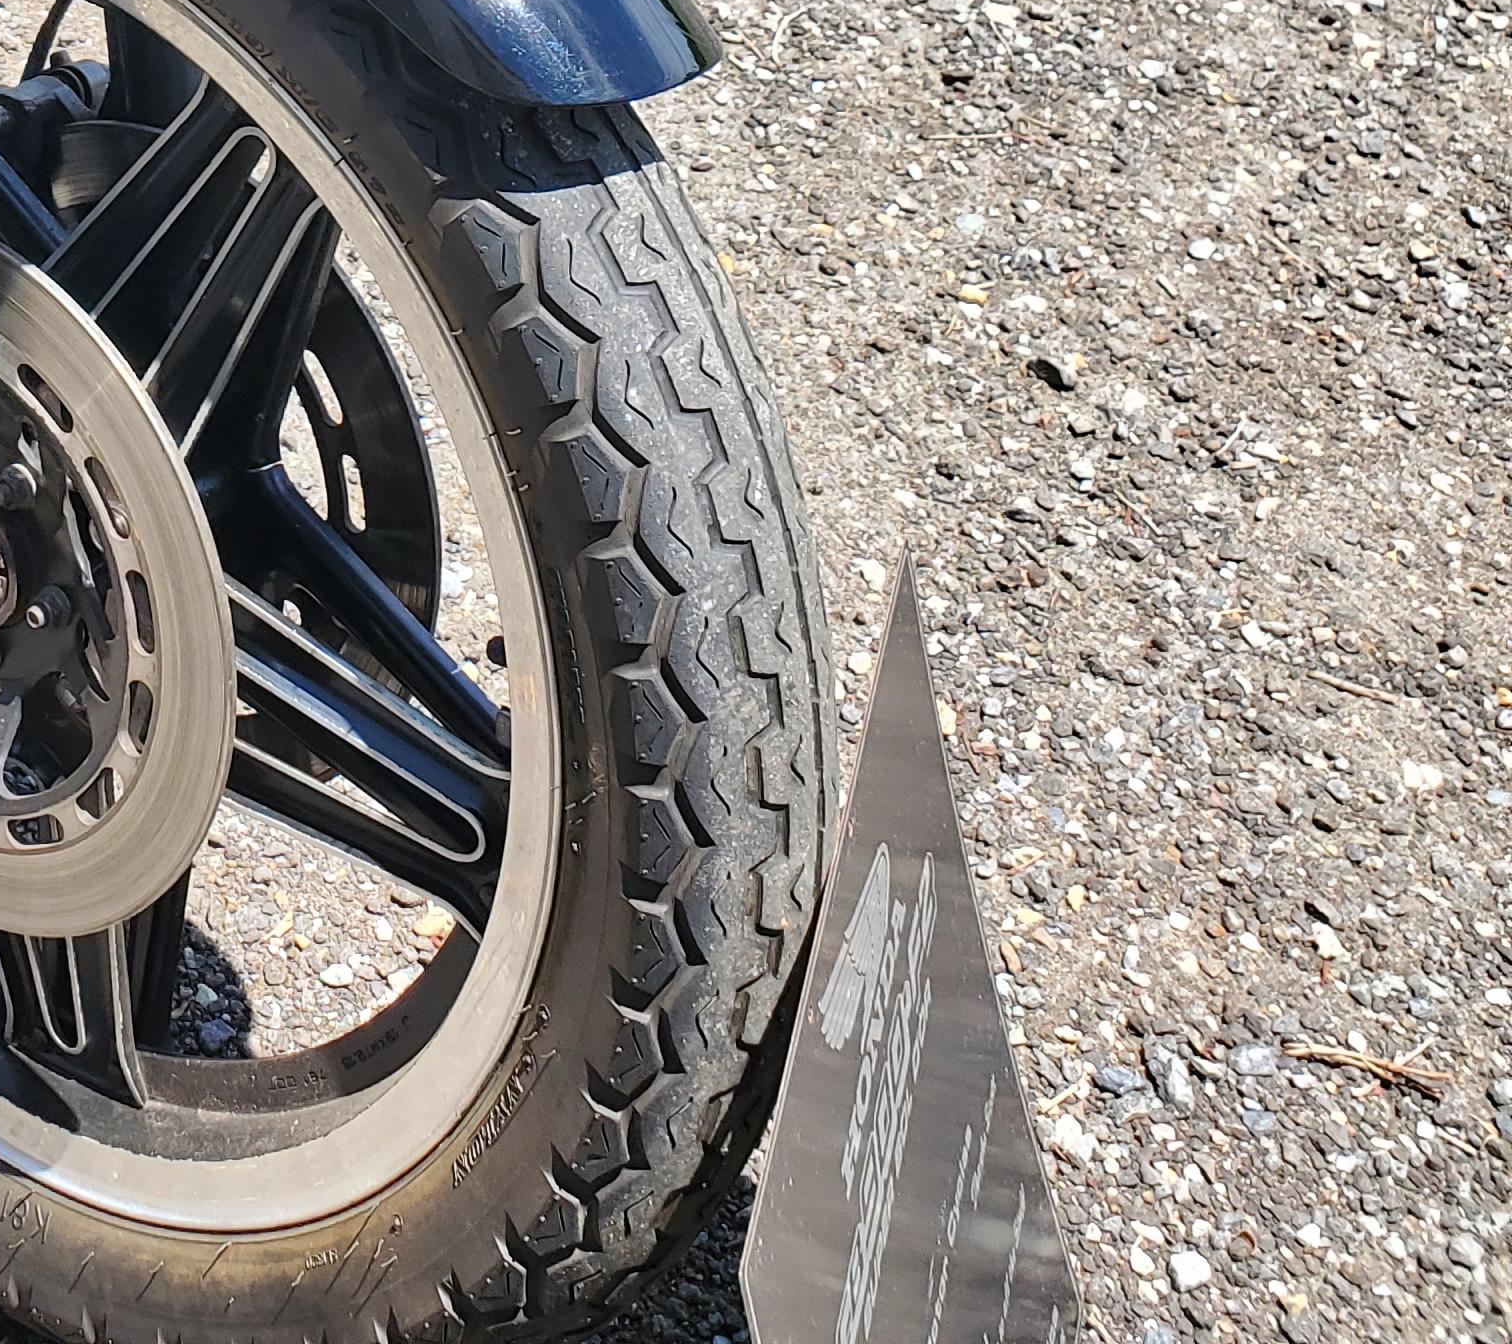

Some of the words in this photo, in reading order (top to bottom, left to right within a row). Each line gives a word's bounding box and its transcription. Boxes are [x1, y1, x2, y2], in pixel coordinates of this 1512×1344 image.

[840, 898, 907, 1201] HONDA
[0, 1188, 52, 1246] K81
[863, 1174, 895, 1341] SUPER
[946, 1123, 972, 1249] Cycles
